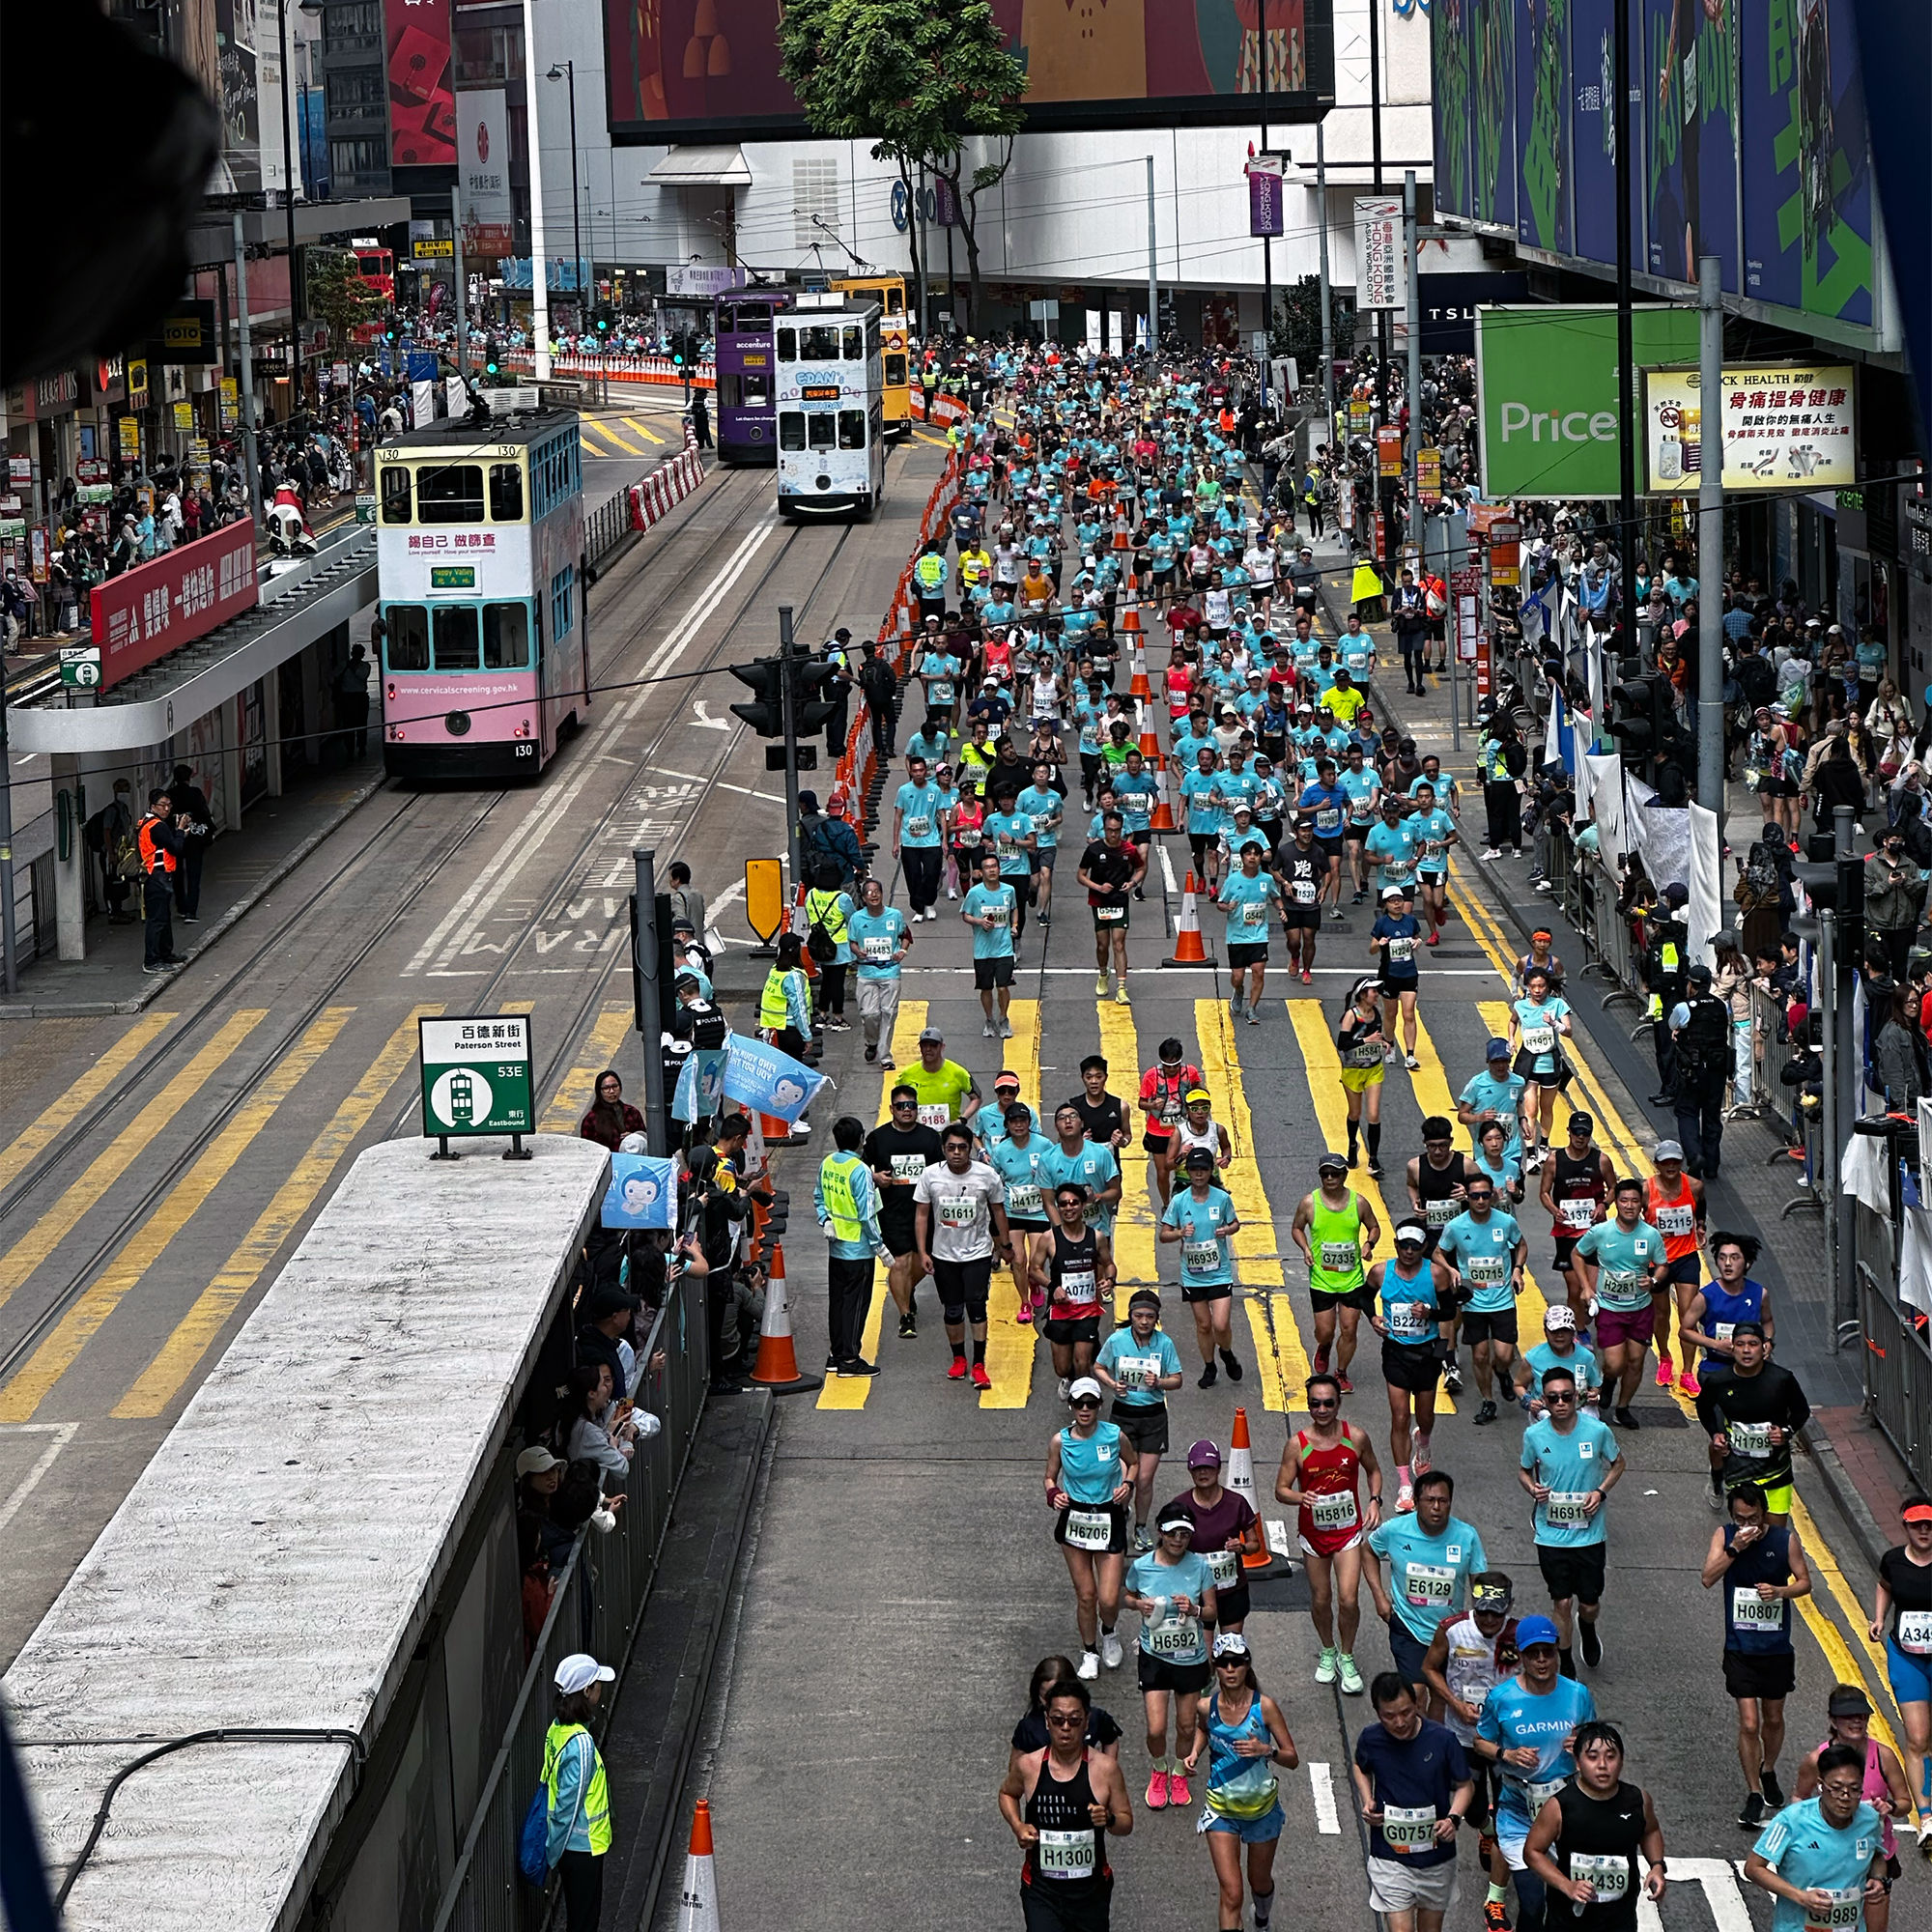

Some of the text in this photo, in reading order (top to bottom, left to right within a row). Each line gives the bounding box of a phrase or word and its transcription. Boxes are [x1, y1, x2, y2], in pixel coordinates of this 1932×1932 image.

[1372, 221, 1383, 304] HONG KONG
[857, 265, 877, 275] 172
[1429, 308, 1474, 320] TSL
[1721, 375, 1790, 385] CK HEALTH
[1729, 387, 1847, 410] 骨痛搵骨健康
[1501, 402, 1618, 442] Price
[383, 449, 399, 460] 130
[498, 445, 516, 456] 130
[408, 533, 496, 549] 錫自己 做篩查
[400, 683, 519, 696] www.cervicalscreening.gov.hk
[515, 745, 532, 756] 130
[1293, 860, 1313, 877] 跑
[462, 1025, 520, 1039] 百德新街
[454, 1041, 493, 1050] Paterson
[497, 1066, 523, 1077] 53E
[489, 1118, 525, 1126] Eastbound
[922, 1114, 946, 1125] 9188
[894, 1165, 924, 1177] G4527
[1012, 1194, 1043, 1207] H4172
[943, 1208, 975, 1219] G1611
[1658, 1215, 1691, 1230] B2115
[1187, 1251, 1219, 1265] H6938
[1470, 1267, 1504, 1281] G0715
[1604, 1281, 1635, 1293] H2281
[1733, 1435, 1771, 1449] H1799
[1316, 1504, 1353, 1522] H5816
[1069, 1523, 1108, 1540] H6706
[1213, 1564, 1236, 1579] 817
[1408, 1579, 1451, 1596] E6129
[1738, 1604, 1780, 1620] H0807
[1902, 1627, 1932, 1642] A34
[1153, 1633, 1196, 1651] H6592
[1516, 1719, 1575, 1735] GARMIN
[1386, 1823, 1434, 1841] G0757
[1044, 1848, 1092, 1866] H1300
